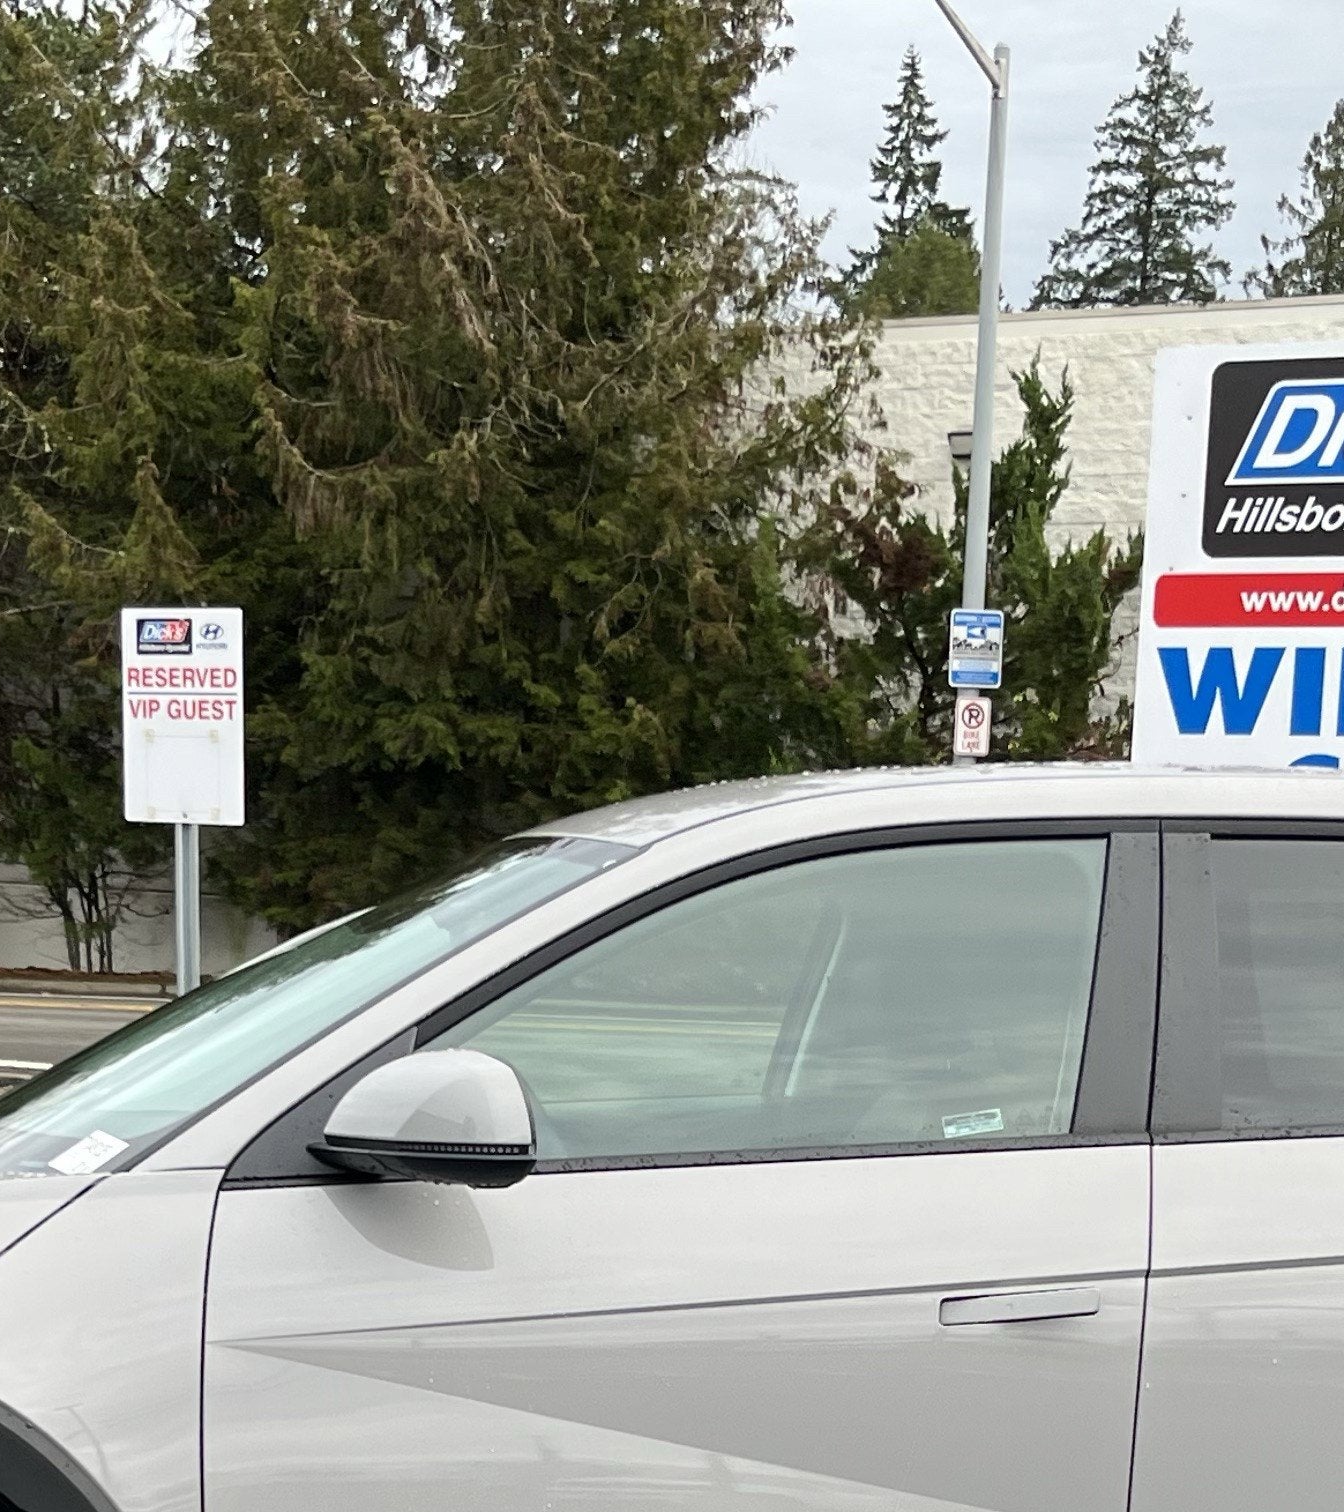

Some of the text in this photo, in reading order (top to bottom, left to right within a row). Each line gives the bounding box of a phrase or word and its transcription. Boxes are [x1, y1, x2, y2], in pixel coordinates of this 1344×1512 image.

[127, 667, 237, 688] RESERVED
[129, 699, 237, 720] VIP GUEST
